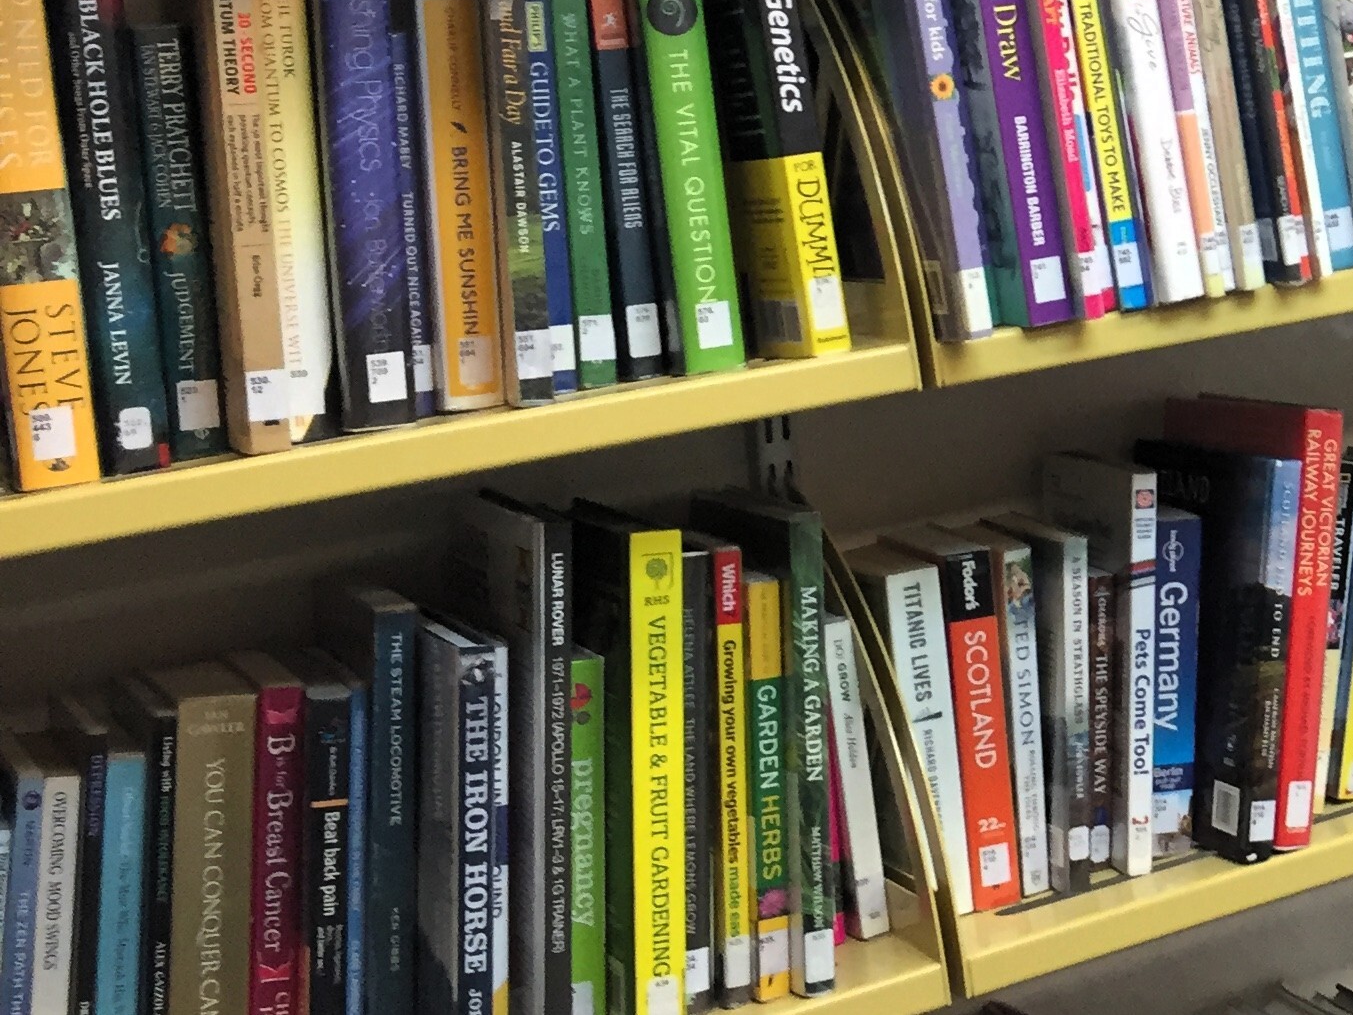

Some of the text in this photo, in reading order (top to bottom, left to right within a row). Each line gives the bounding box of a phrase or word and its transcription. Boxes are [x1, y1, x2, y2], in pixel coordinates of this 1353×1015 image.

[220, 38, 242, 96] THEORY
[926, 24, 949, 62] kids
[991, 2, 1027, 84] Draw
[86, 79, 113, 145] HOLE
[154, 37, 196, 215] TERRY PRATCHETT
[348, 78, 388, 174] Physics
[529, 60, 562, 233] GUIDE TO GEMS
[611, 111, 636, 159] SEARCH
[1078, 1, 1108, 104] TRADITIONAL
[1095, 105, 1114, 145] TOYS
[1106, 170, 1126, 213] MAKE
[93, 147, 122, 222] BLUES
[509, 140, 530, 254] ALASTAIR DAWSON
[618, 185, 644, 231] ALIENS
[667, 48, 717, 303] THE VITAL QUESTION
[1011, 114, 1046, 247] BARRINGTON BARBER
[97, 259, 133, 386] JANNA LEVIN
[165, 269, 199, 376] JUDGEMENT
[1293, 427, 1324, 597] RAILWAY JOURNEYS
[1311, 437, 1339, 588] GREAT VICTORIAN
[959, 558, 981, 611] Fodor's
[646, 614, 668, 748] VEGETABLE
[961, 629, 999, 771] SCOTLAND
[1012, 618, 1036, 747] TED SIMON
[1133, 627, 1152, 776] Pets Come Too!
[1149, 579, 1189, 732] Germany
[650, 773, 670, 841] FRUIT
[684, 744, 696, 784] LAND
[684, 783, 696, 833] WHERE
[756, 683, 782, 881] GARDEN HERBS
[40, 790, 70, 973] OVERCOMING MOOD SWINGS
[194, 756, 226, 975] YOU CAN CONQUER
[322, 810, 341, 846] Beat
[322, 847, 341, 883] back
[463, 695, 489, 975] THE IRON HORSE
[570, 756, 594, 927] pregnancy
[684, 834, 697, 891] LEMONS
[317, 884, 338, 918] pain
[649, 845, 672, 980] GARDENING
[684, 892, 697, 936] GROW
